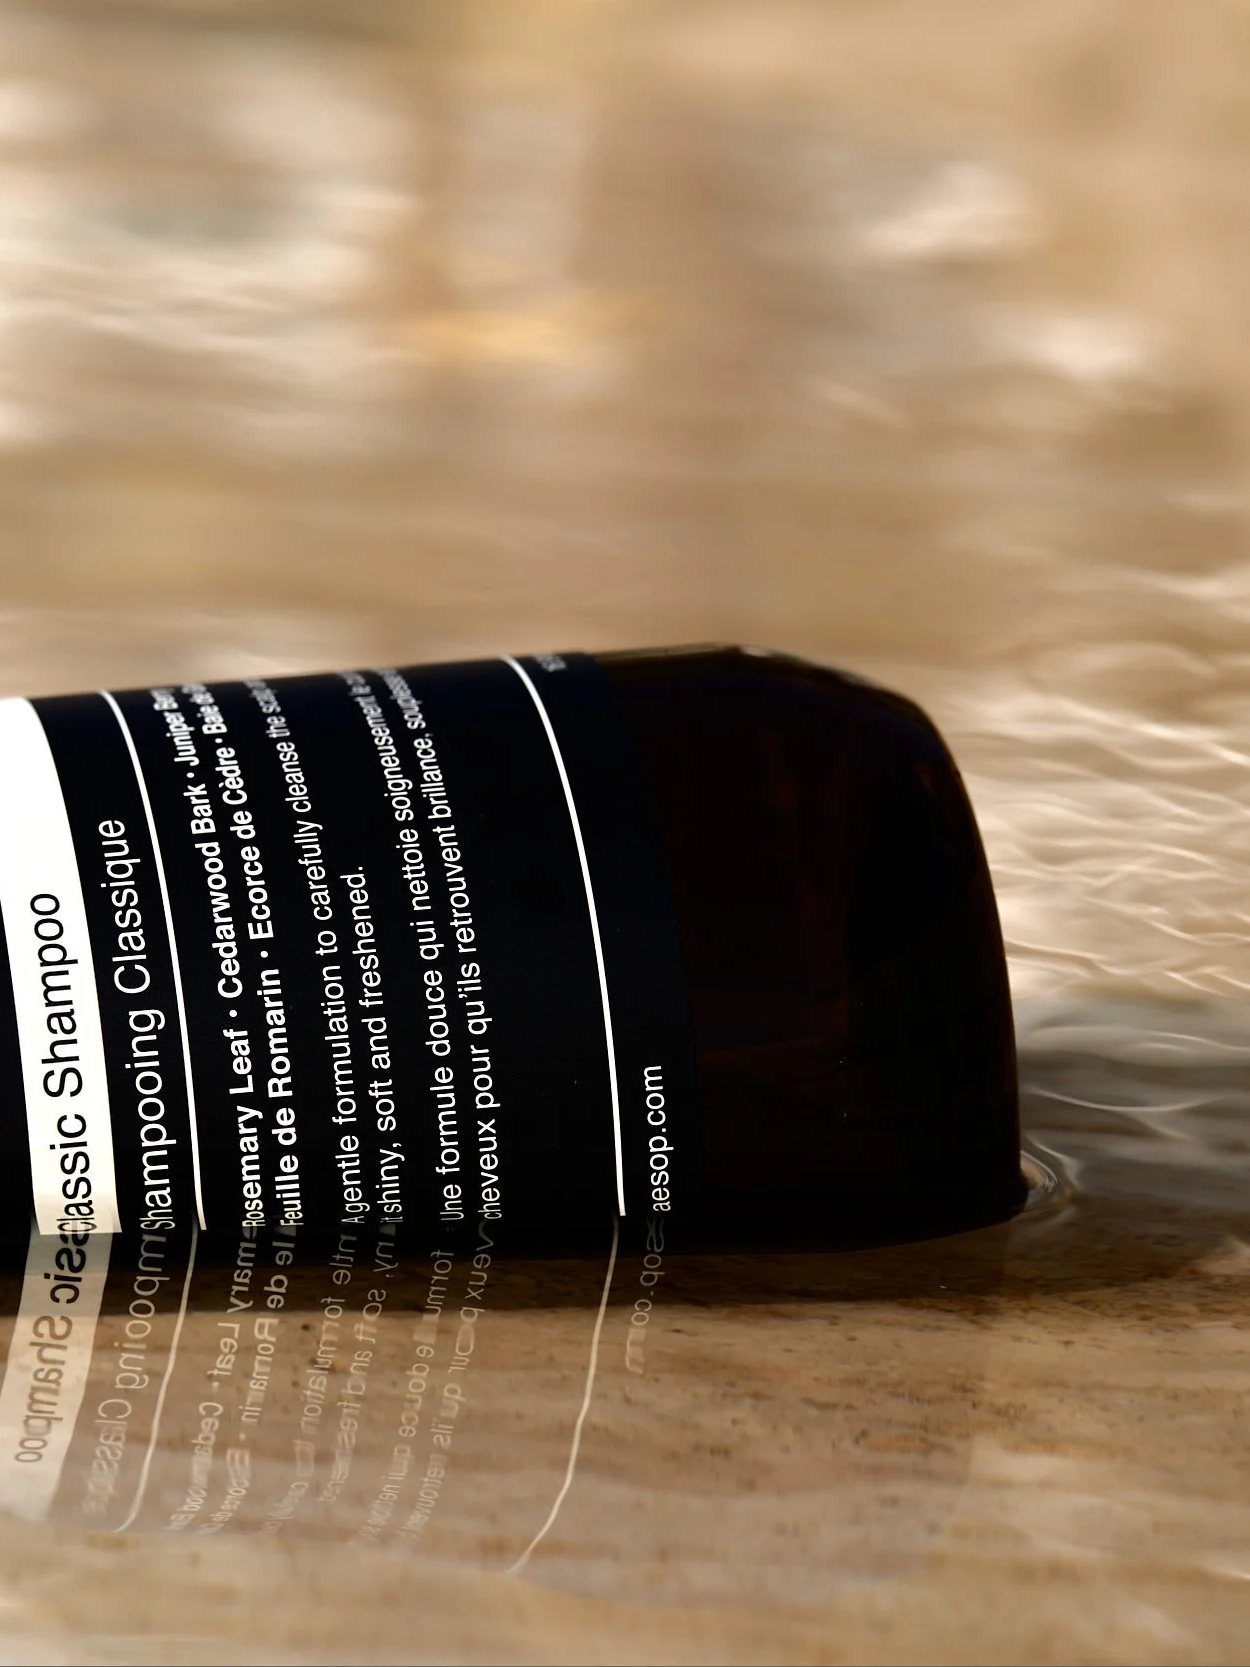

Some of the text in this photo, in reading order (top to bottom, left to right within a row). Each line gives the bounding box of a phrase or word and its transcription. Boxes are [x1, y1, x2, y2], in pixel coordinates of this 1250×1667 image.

[163, 711, 200, 766] Juniper
[265, 715, 290, 738] the
[354, 694, 414, 822] soigneusement
[183, 784, 216, 834] Bark
[215, 747, 248, 805] Cèdre
[276, 741, 312, 812] cleanse
[230, 810, 256, 839] de
[241, 846, 274, 939] Ecorce
[293, 820, 333, 921] carefully
[395, 828, 432, 911] nettoie
[432, 824, 477, 953] retrouvent
[195, 842, 243, 998] Cedarwood
[315, 930, 338, 956] to
[340, 866, 384, 1008] freshened.
[410, 920, 444, 960] qui
[98, 819, 176, 1230] Shampooing Classique
[256, 968, 293, 1098] Romarin
[320, 965, 357, 1125] formulation
[361, 1017, 391, 1069] and
[423, 970, 453, 1056] douce
[30, 893, 97, 1233] Classic Shampoo
[223, 1029, 254, 1094] Leaf
[470, 1044, 500, 1109] pour
[271, 1107, 297, 1146] de
[368, 1079, 396, 1131] soft
[430, 1066, 460, 1175] formule
[643, 1065, 674, 1212] aesop.com
[236, 1105, 266, 1227] Rosemary
[275, 1155, 304, 1226] Feuille
[335, 1135, 370, 1213] gentle
[375, 1142, 405, 1213] shiny,
[440, 1183, 464, 1221] Une
[477, 1118, 502, 1221] cheveux
[341, 1215, 366, 1224] A
